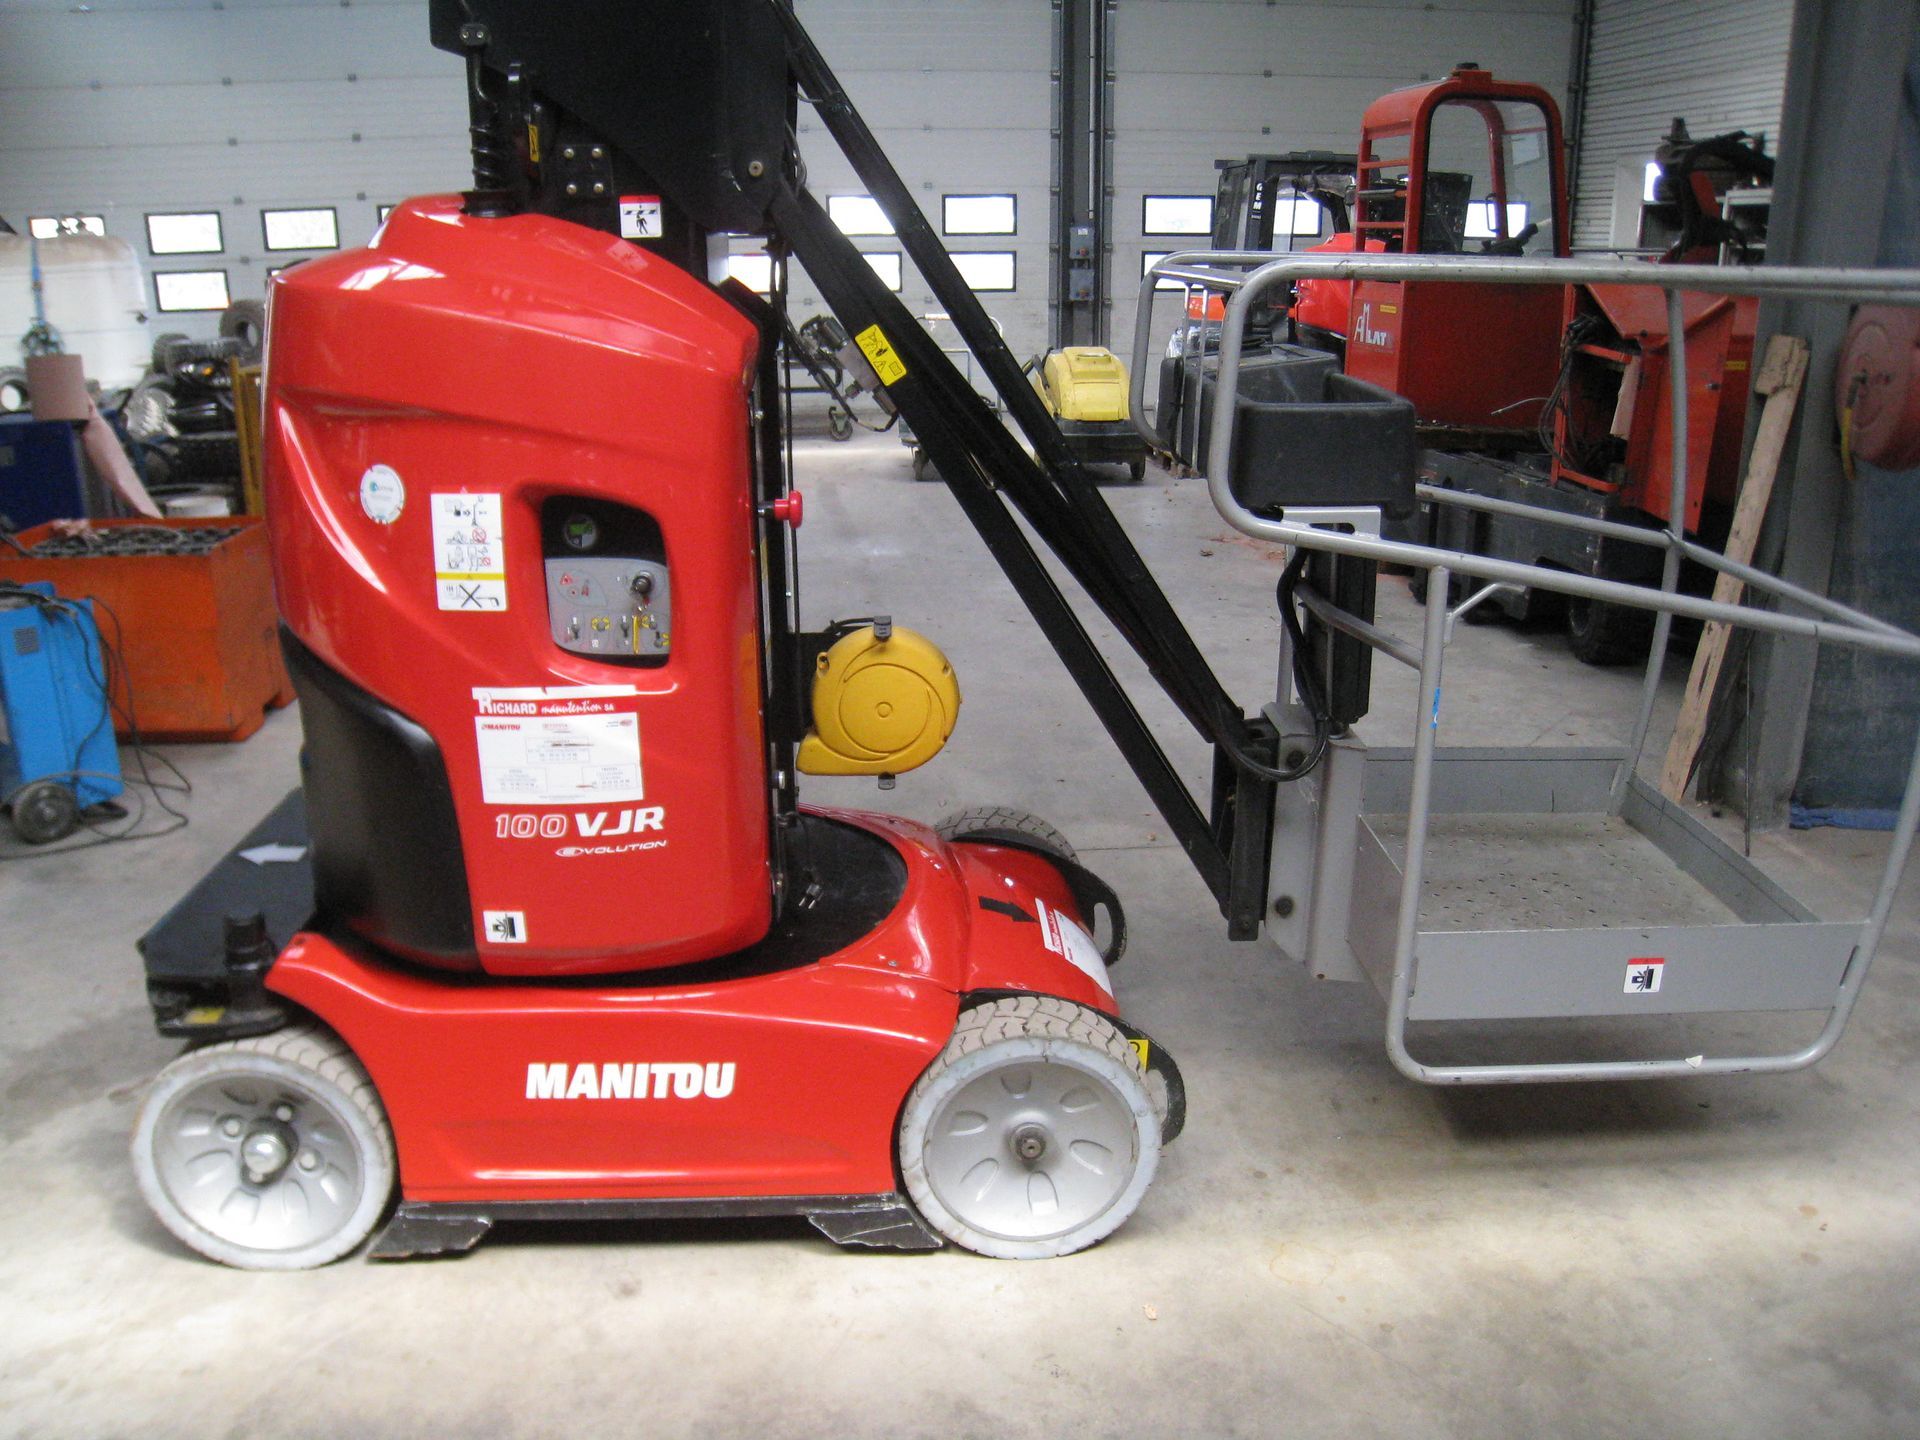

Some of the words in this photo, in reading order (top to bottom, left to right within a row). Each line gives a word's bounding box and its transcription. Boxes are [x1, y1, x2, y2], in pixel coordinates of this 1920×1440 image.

[479, 692, 537, 715] RICHARD
[541, 700, 602, 714] manutention
[604, 703, 614, 711] SA
[486, 723, 521, 731] MANITOU
[495, 813, 567, 838] 100
[574, 806, 664, 837] VJR
[555, 840, 667, 857] EVOLUTION
[525, 1062, 736, 1099] MANITOU
